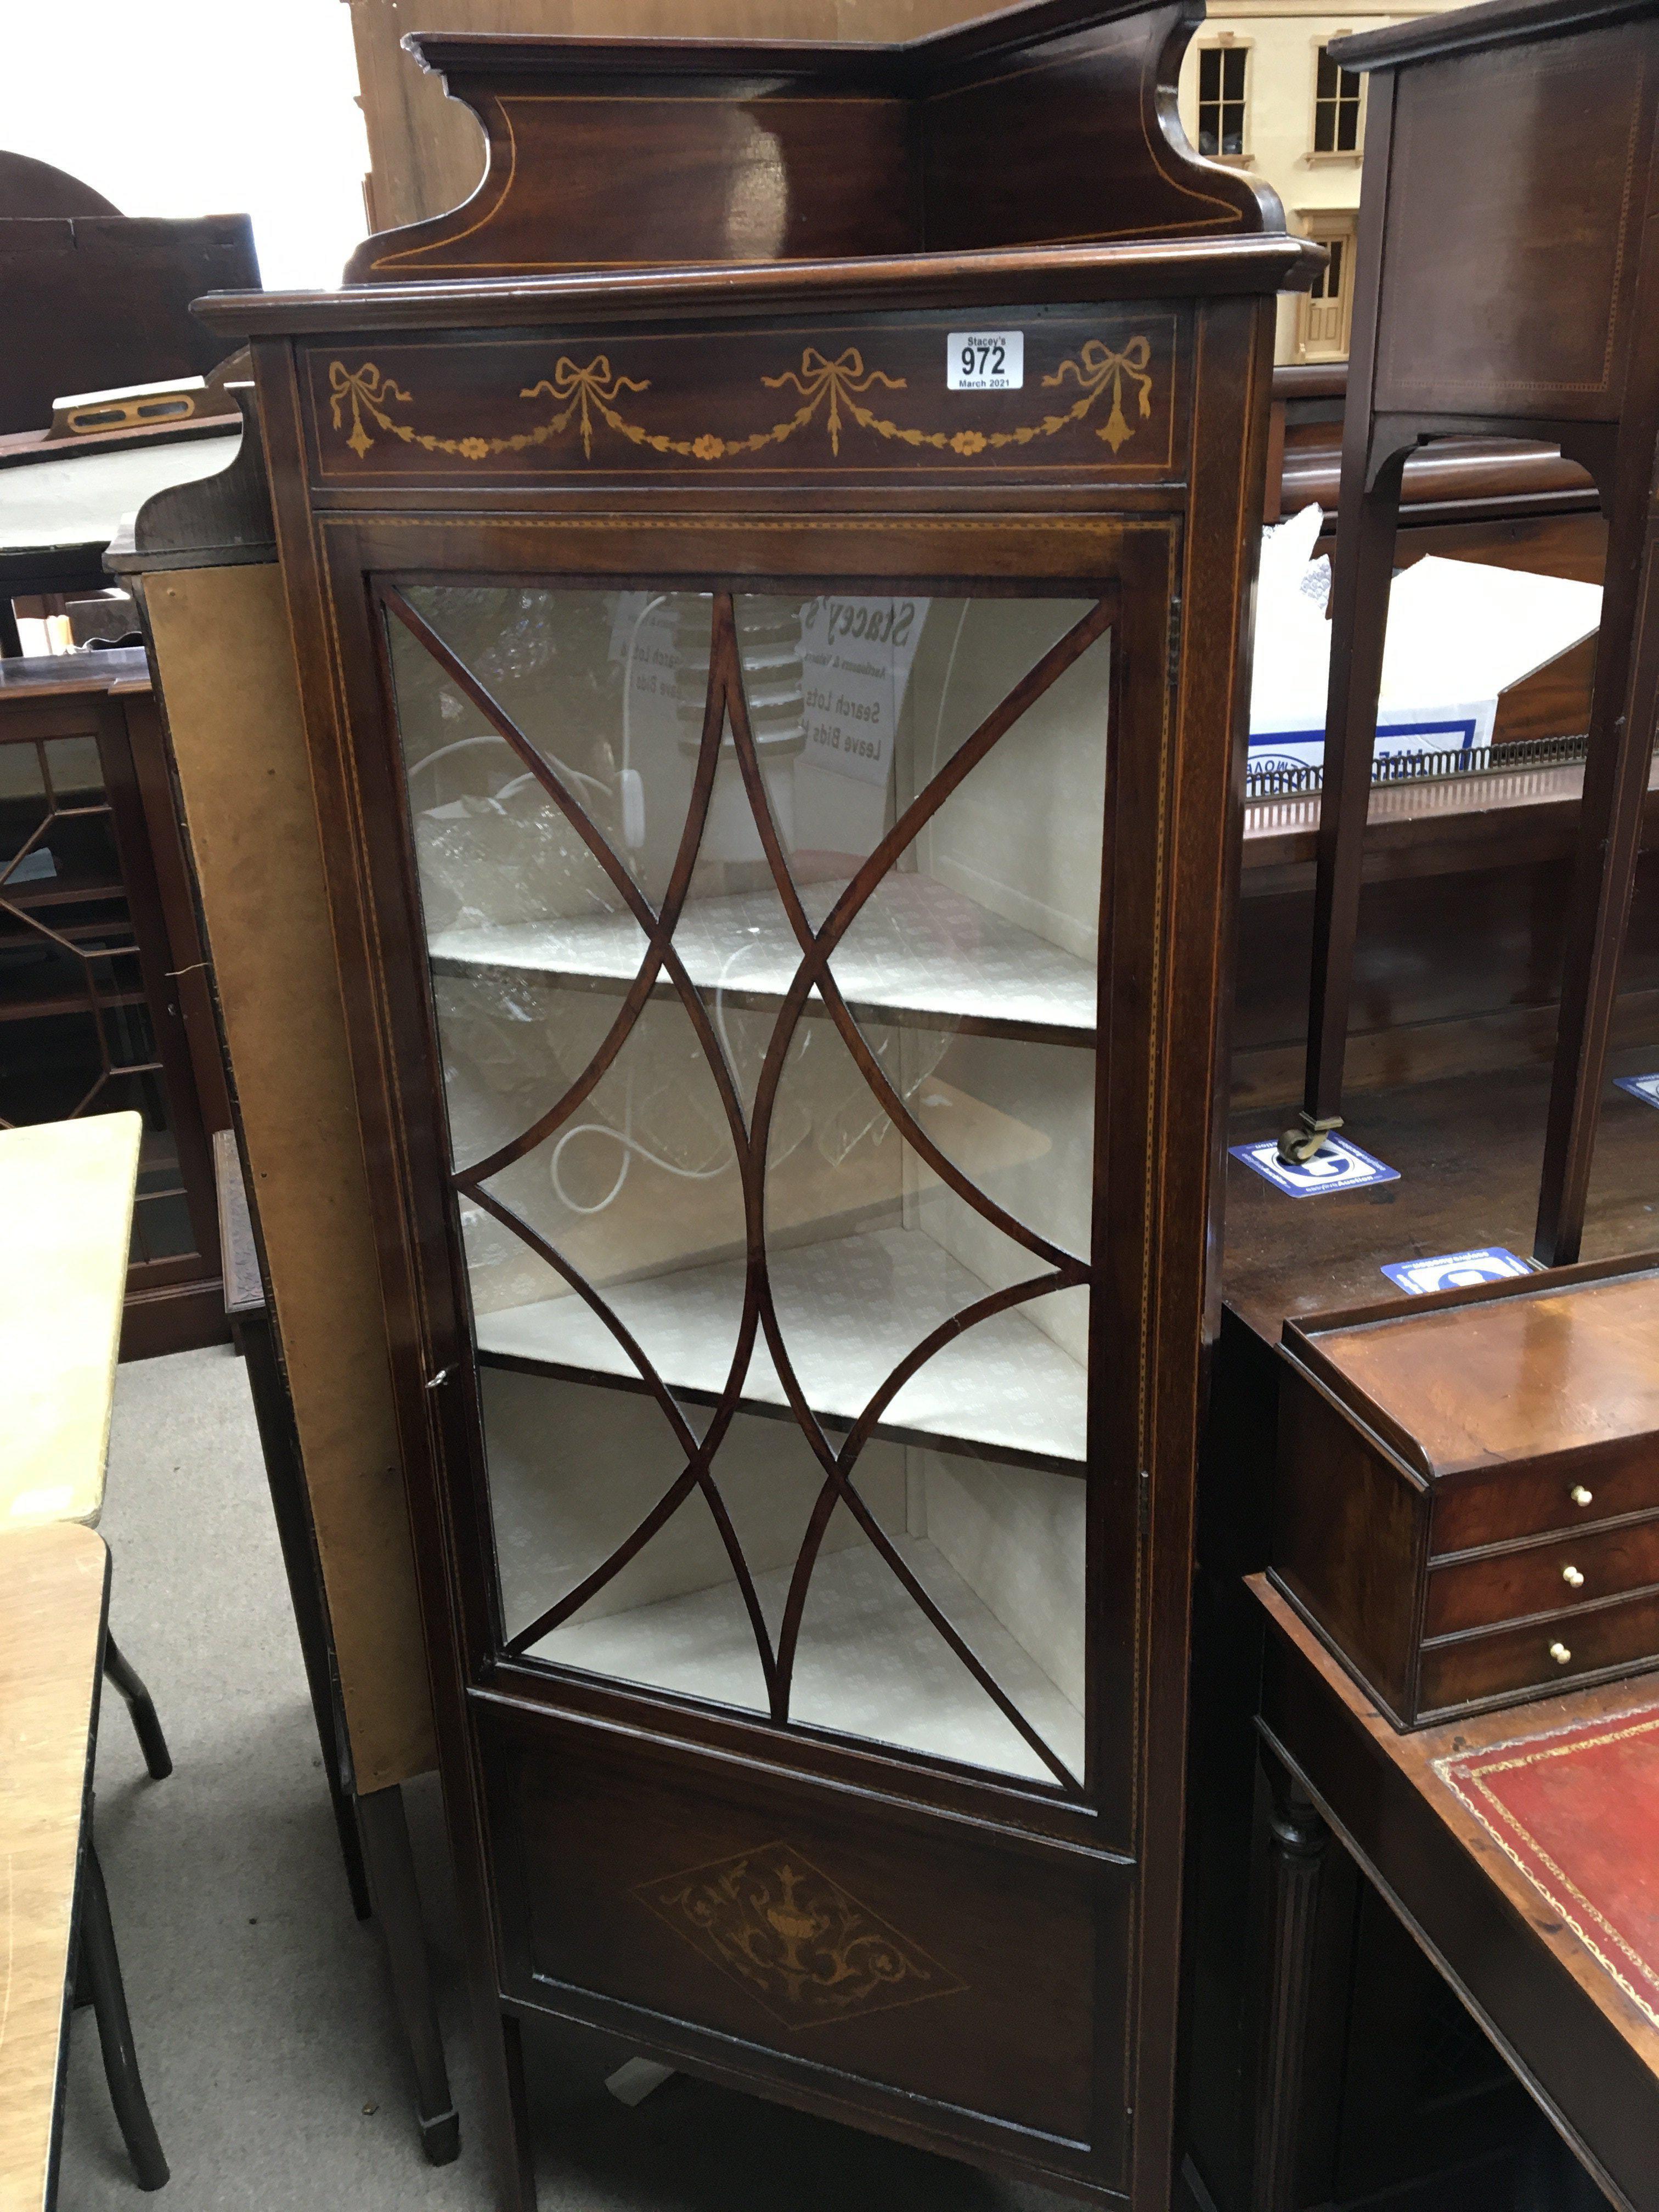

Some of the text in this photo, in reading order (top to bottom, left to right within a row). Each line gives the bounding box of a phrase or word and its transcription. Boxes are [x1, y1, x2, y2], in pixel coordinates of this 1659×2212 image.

[967, 336, 1006, 347] Stacey's
[961, 346, 1005, 375] 972
[959, 379, 1010, 388] March 2021
